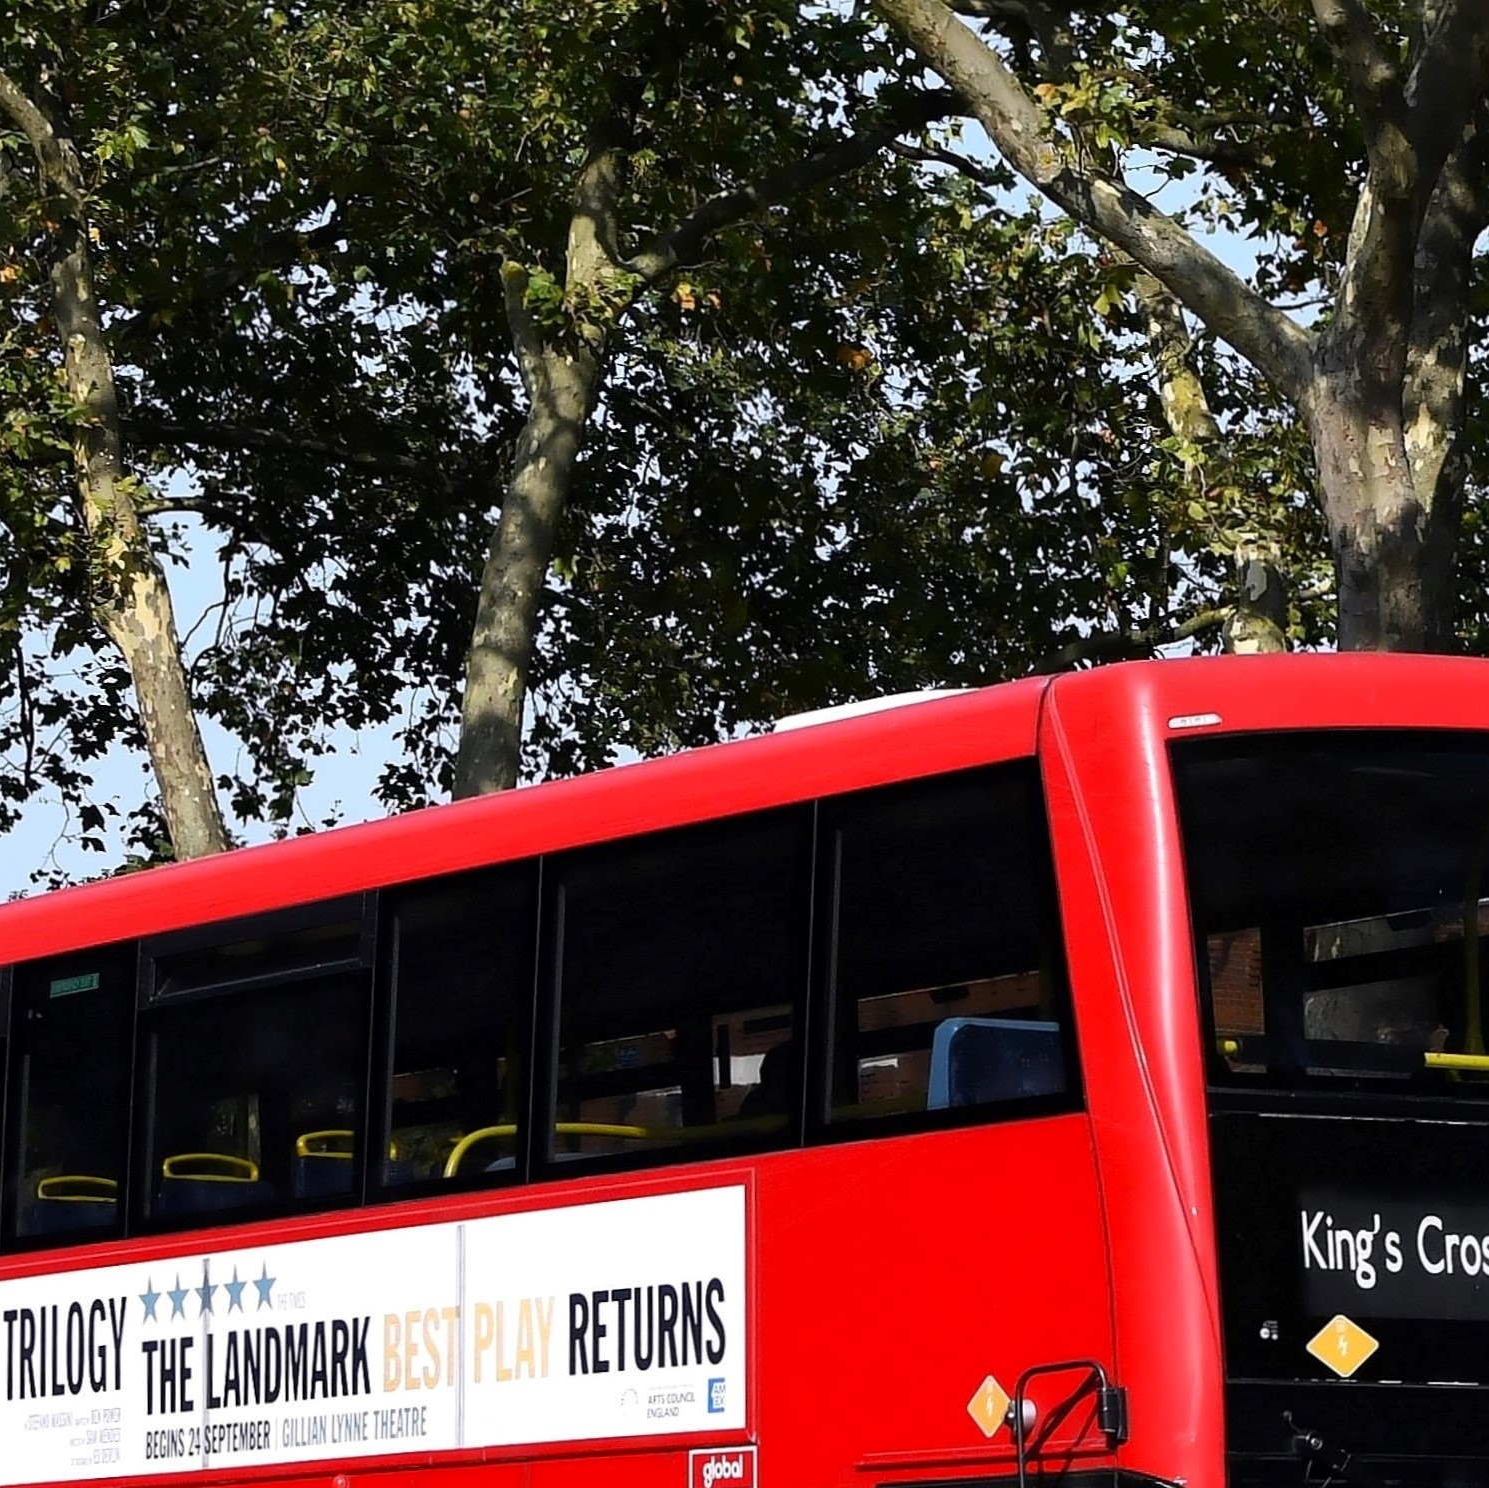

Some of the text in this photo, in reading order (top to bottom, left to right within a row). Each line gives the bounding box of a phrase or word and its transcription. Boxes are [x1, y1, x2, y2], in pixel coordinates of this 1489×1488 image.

[1301, 1210, 1404, 1289] King's
[3, 1296, 127, 1400] TRILOGY
[142, 1277, 726, 1415] THE LANDMARK BEST PLAY RETURNS
[145, 1426, 186, 1460] BEGINS
[203, 1420, 271, 1454] SEPTEMBER
[282, 1405, 428, 1448] GILLIAN LYNNE THEATRE
[702, 1454, 744, 1488] global
